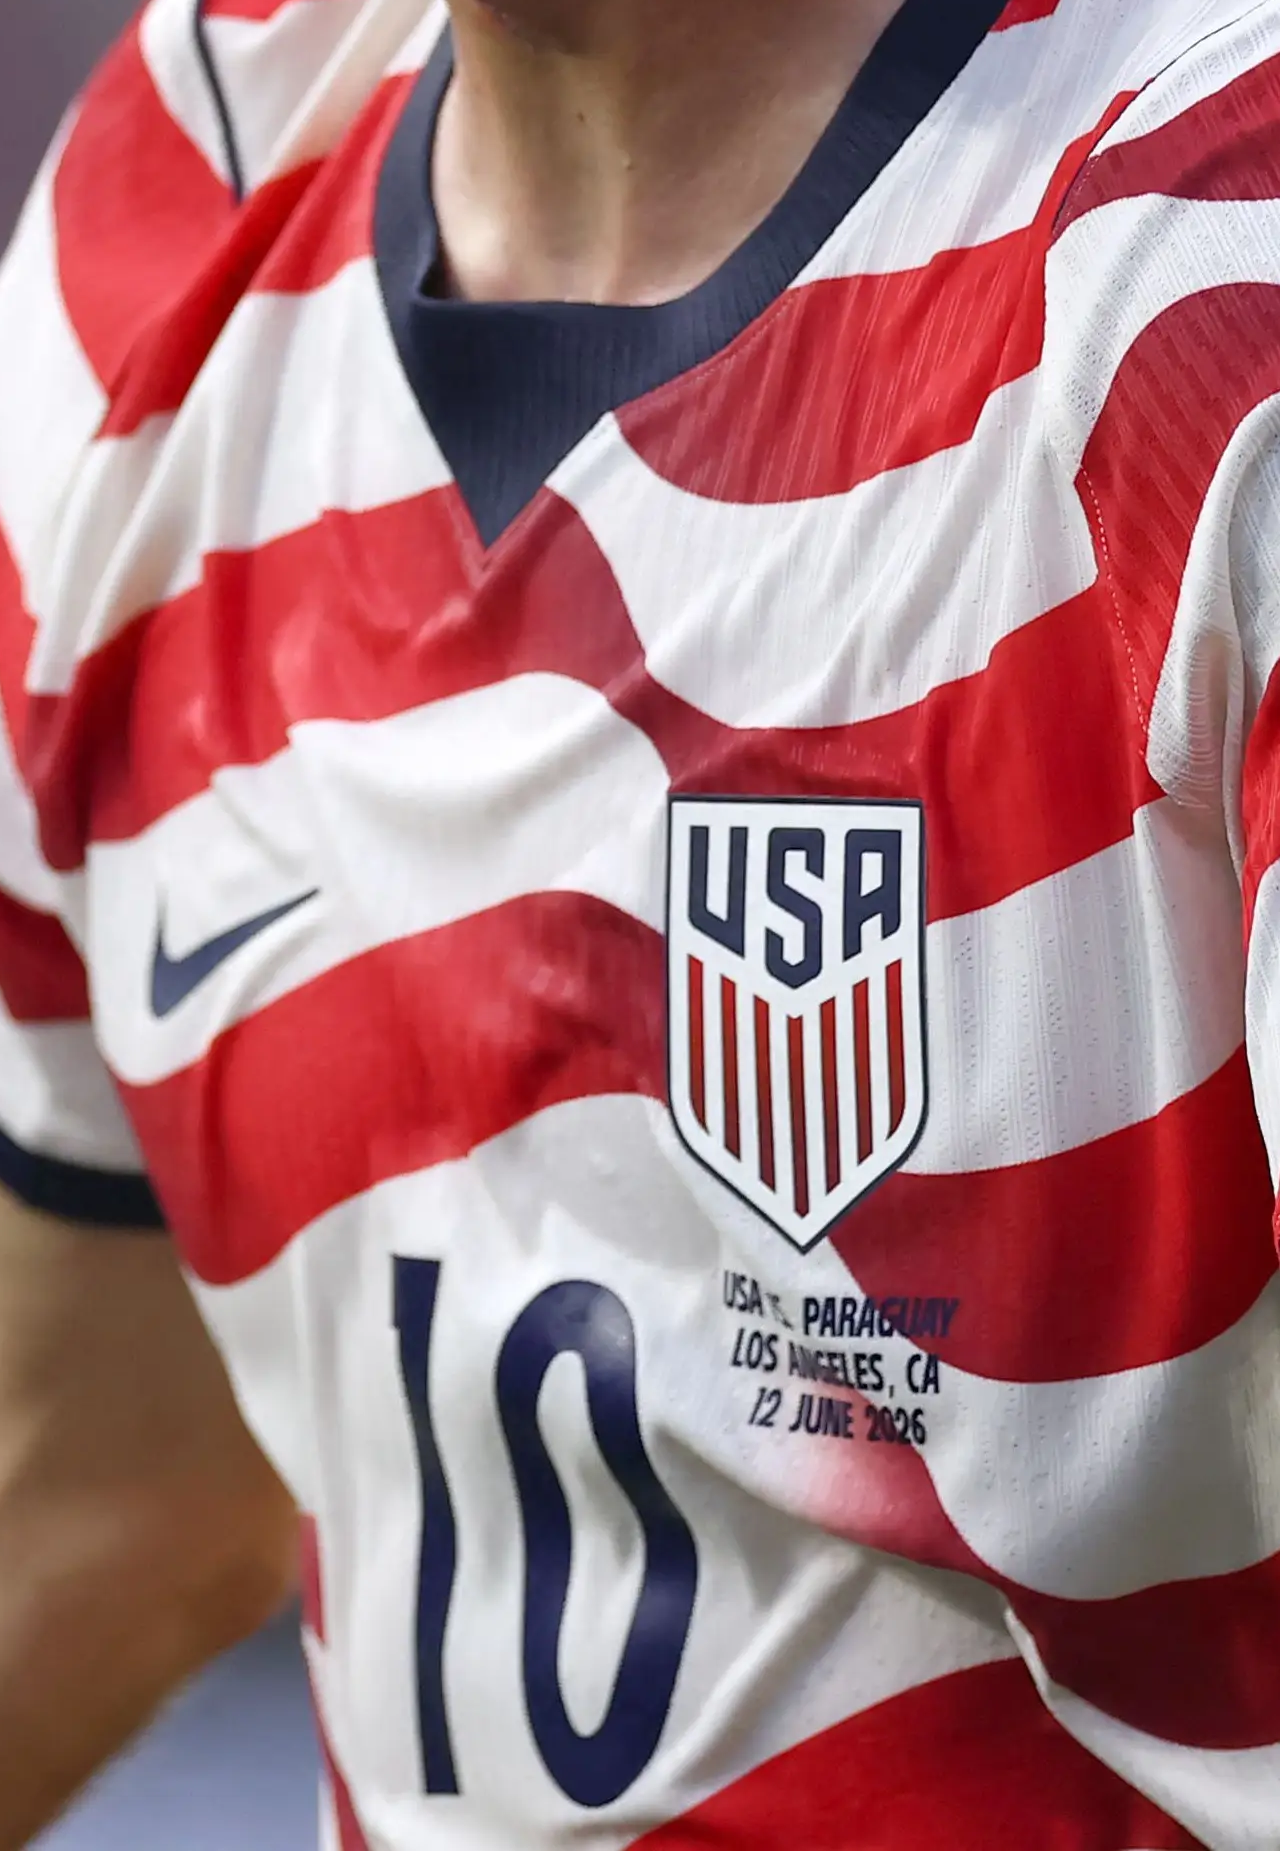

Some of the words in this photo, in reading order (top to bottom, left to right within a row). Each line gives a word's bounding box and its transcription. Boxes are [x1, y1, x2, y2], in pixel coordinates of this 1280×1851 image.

[689, 825, 902, 989] USA
[723, 1270, 763, 1317] USA
[803, 1296, 958, 1337] PARAGUAY
[731, 1327, 778, 1371] LOS
[788, 1340, 895, 1397] ANGELES,
[906, 1354, 940, 1394] CA
[748, 1386, 782, 1427] 12
[788, 1394, 854, 1439] JUNE
[865, 1404, 927, 1445] 2026
[391, 1253, 698, 1808] 10
